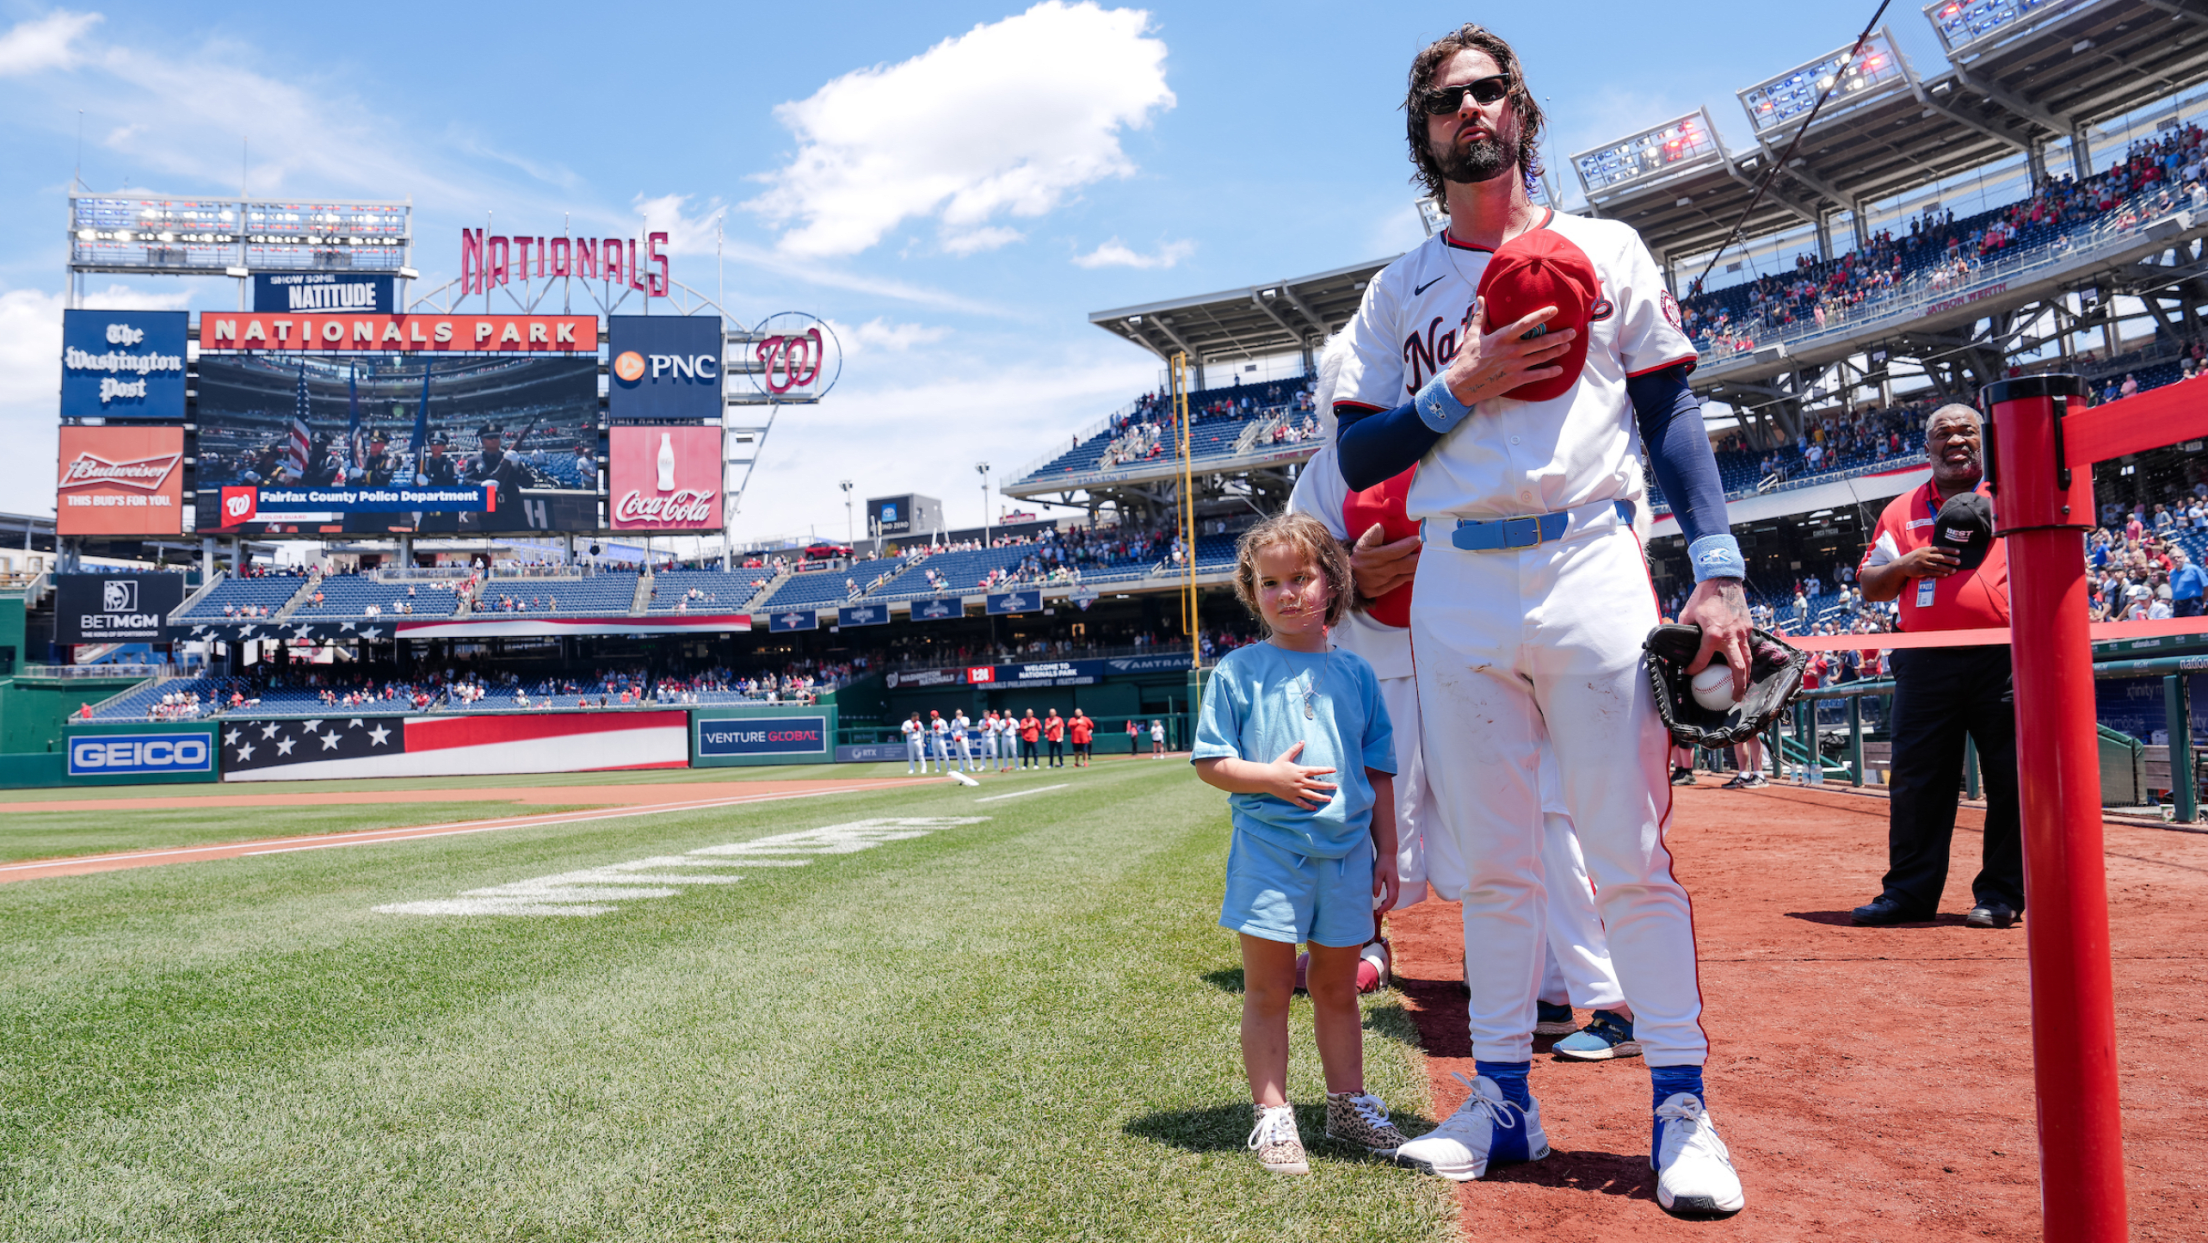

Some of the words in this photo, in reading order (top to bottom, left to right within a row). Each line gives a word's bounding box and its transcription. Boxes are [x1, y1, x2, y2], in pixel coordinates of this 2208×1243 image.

[461, 228, 669, 297] NATIONALS
[270, 275, 304, 285] SHOW
[289, 282, 377, 309] NATITUDE
[1925, 296, 1965, 316] JAYSON
[1968, 282, 2007, 303] WERTH
[105, 323, 144, 347] The
[215, 319, 453, 343] NATIONALS
[475, 322, 576, 343] PARK
[65, 346, 183, 375] Washington
[648, 354, 717, 379] PNC
[99, 377, 147, 403] Post
[69, 460, 168, 479] Budweiser
[67, 495, 92, 506] THIS
[93, 495, 125, 506] BUD'S
[126, 495, 148, 506] FOR
[148, 495, 172, 507] YOU.
[260, 491, 307, 503] Fairfax
[309, 491, 357, 504] County
[359, 490, 399, 502] Police
[401, 490, 479, 503] Department
[616, 490, 716, 522] Coca-Cola
[1946, 527, 1974, 537] BEST
[81, 614, 159, 629] BETMGM
[1024, 663, 1058, 672] WELCOME
[1060, 662, 1070, 670] TO
[1131, 658, 1191, 669] AMTRAK
[900, 670, 941, 682] WASHINGTON
[1018, 670, 1058, 680] NATIONALS
[1058, 668, 1078, 677] PARK
[2126, 682, 2155, 700] xfinity
[706, 731, 766, 744] VENTURE
[768, 730, 819, 742] GLOBAL
[74, 740, 207, 768] GEICO
